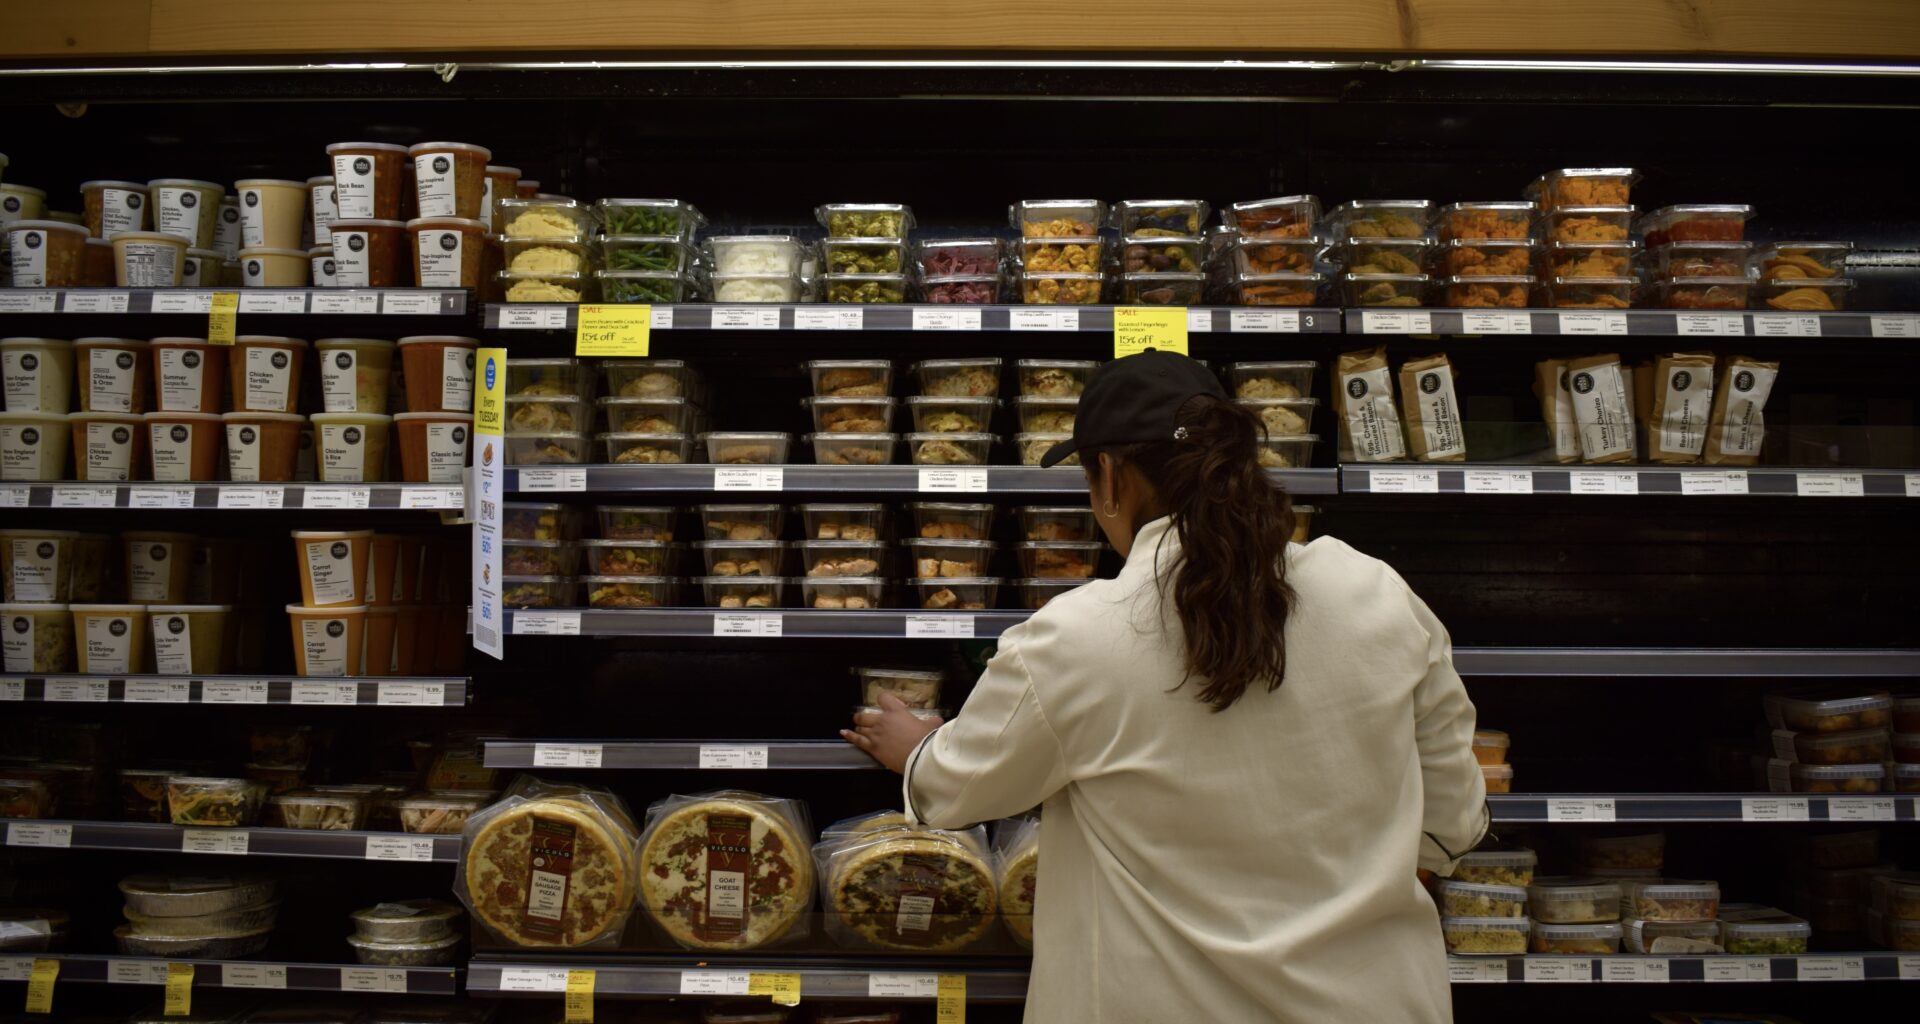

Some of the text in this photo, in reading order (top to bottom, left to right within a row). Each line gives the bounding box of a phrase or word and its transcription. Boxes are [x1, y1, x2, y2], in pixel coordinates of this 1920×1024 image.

[448, 297, 455, 308] 1
[1306, 316, 1314, 327] 3
[582, 332, 617, 341] 15% off
[1120, 335, 1154, 344] 15% off
[484, 396, 496, 410] Every
[479, 411, 500, 423] TUESDAY
[1743, 401, 1753, 425] Cheese
[1362, 413, 1370, 439] Cheese
[1434, 408, 1443, 435] Cheese
[1439, 397, 1453, 451] Uncured Bacon
[1595, 398, 1610, 451] Turkey Chorizo
[1367, 402, 1382, 455] Uncured Bacon
[534, 848, 570, 858] VICOLO
[711, 846, 747, 854] VICOLO
[538, 876, 560, 885] ITALIAN
[535, 882, 562, 892] SAUSAGE
[714, 885, 740, 893] CHEESE
[539, 889, 556, 898] PIZZA
